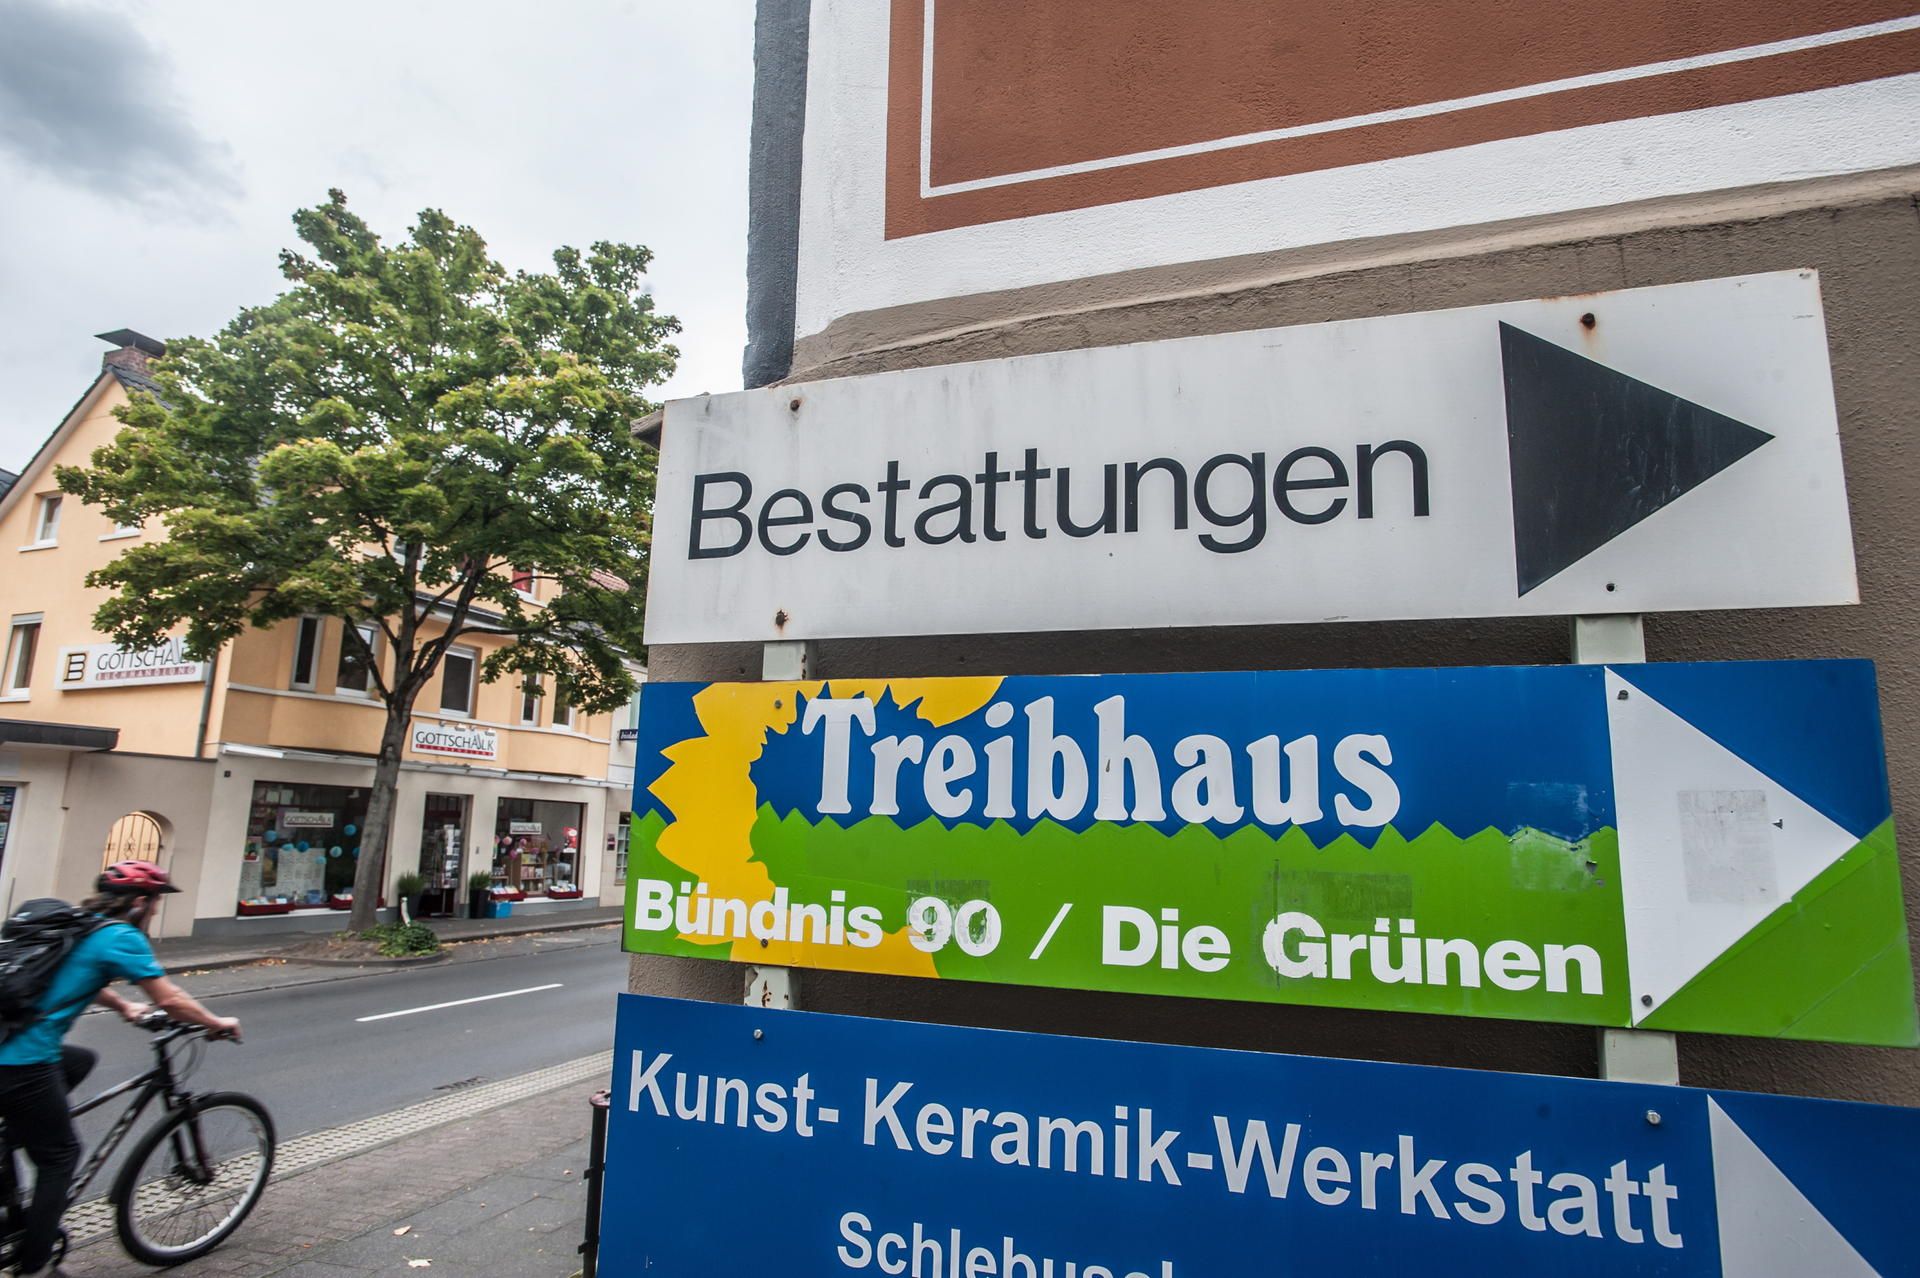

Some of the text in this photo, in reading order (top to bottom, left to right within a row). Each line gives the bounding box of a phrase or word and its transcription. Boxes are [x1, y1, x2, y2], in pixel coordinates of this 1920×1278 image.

[687, 439, 1430, 561] Bestattungen
[97, 640, 189, 671] GOTTSCHAL
[416, 731, 494, 751] GOTTSCHALK
[801, 694, 1401, 828] Treibhaus
[634, 878, 1604, 995] Bündnis 90 / Die Grünen
[627, 1049, 1684, 1249] Kunst- Keramik-Werkstatt
